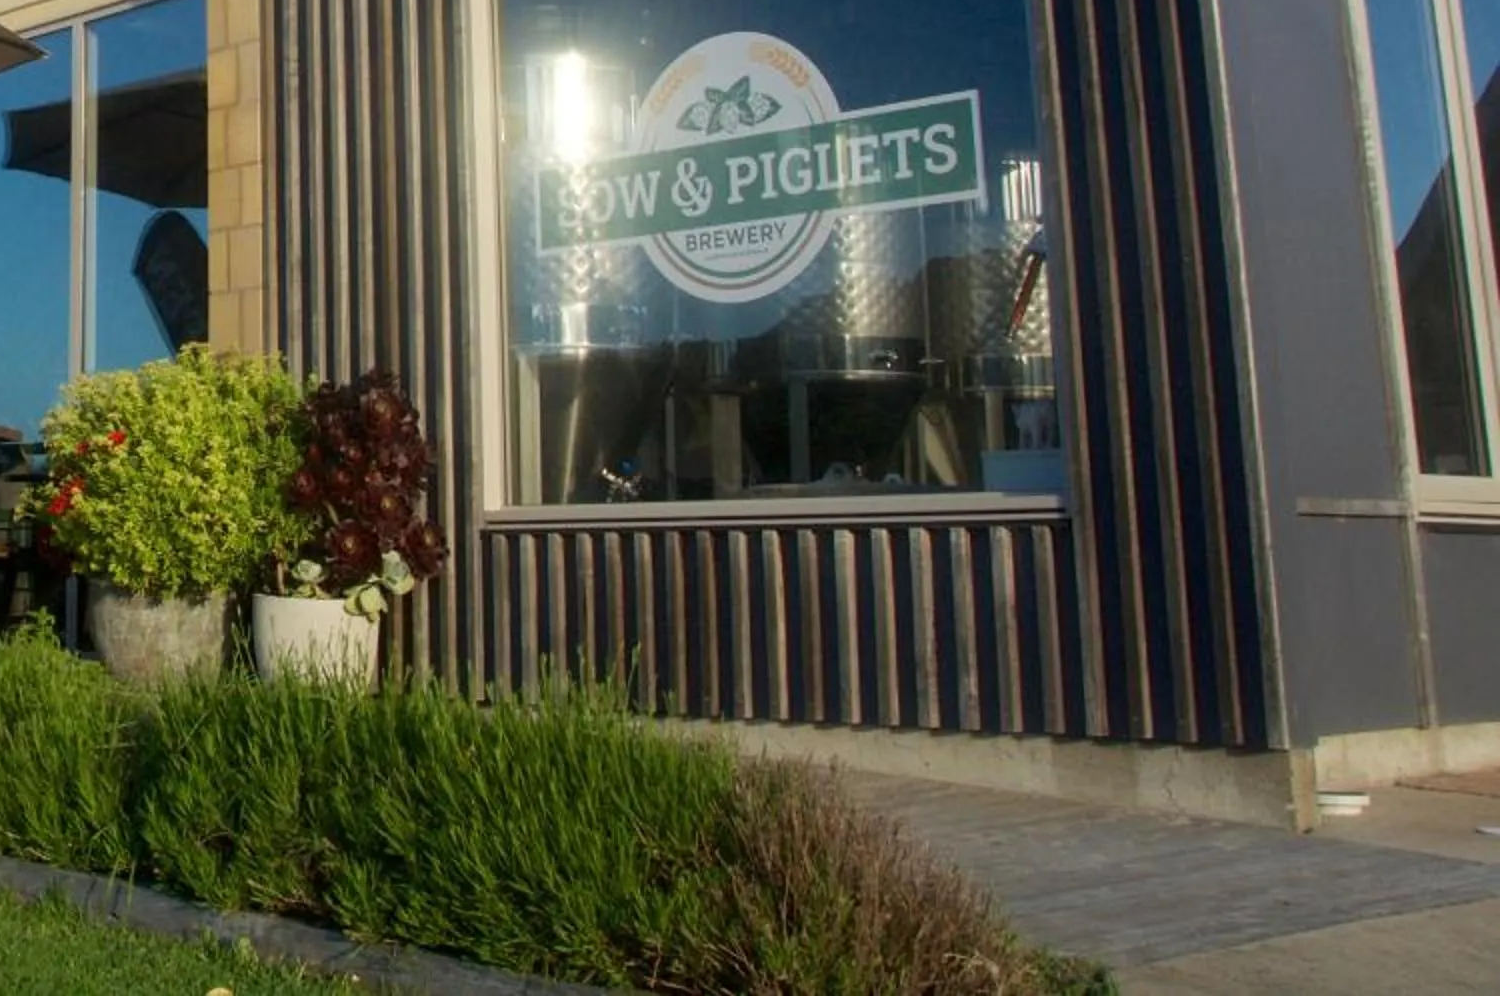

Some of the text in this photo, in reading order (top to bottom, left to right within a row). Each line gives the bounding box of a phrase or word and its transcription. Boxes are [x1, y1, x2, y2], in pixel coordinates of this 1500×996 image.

[557, 122, 959, 228] SOW & PIGLETS
[684, 220, 787, 253] BREWERY
